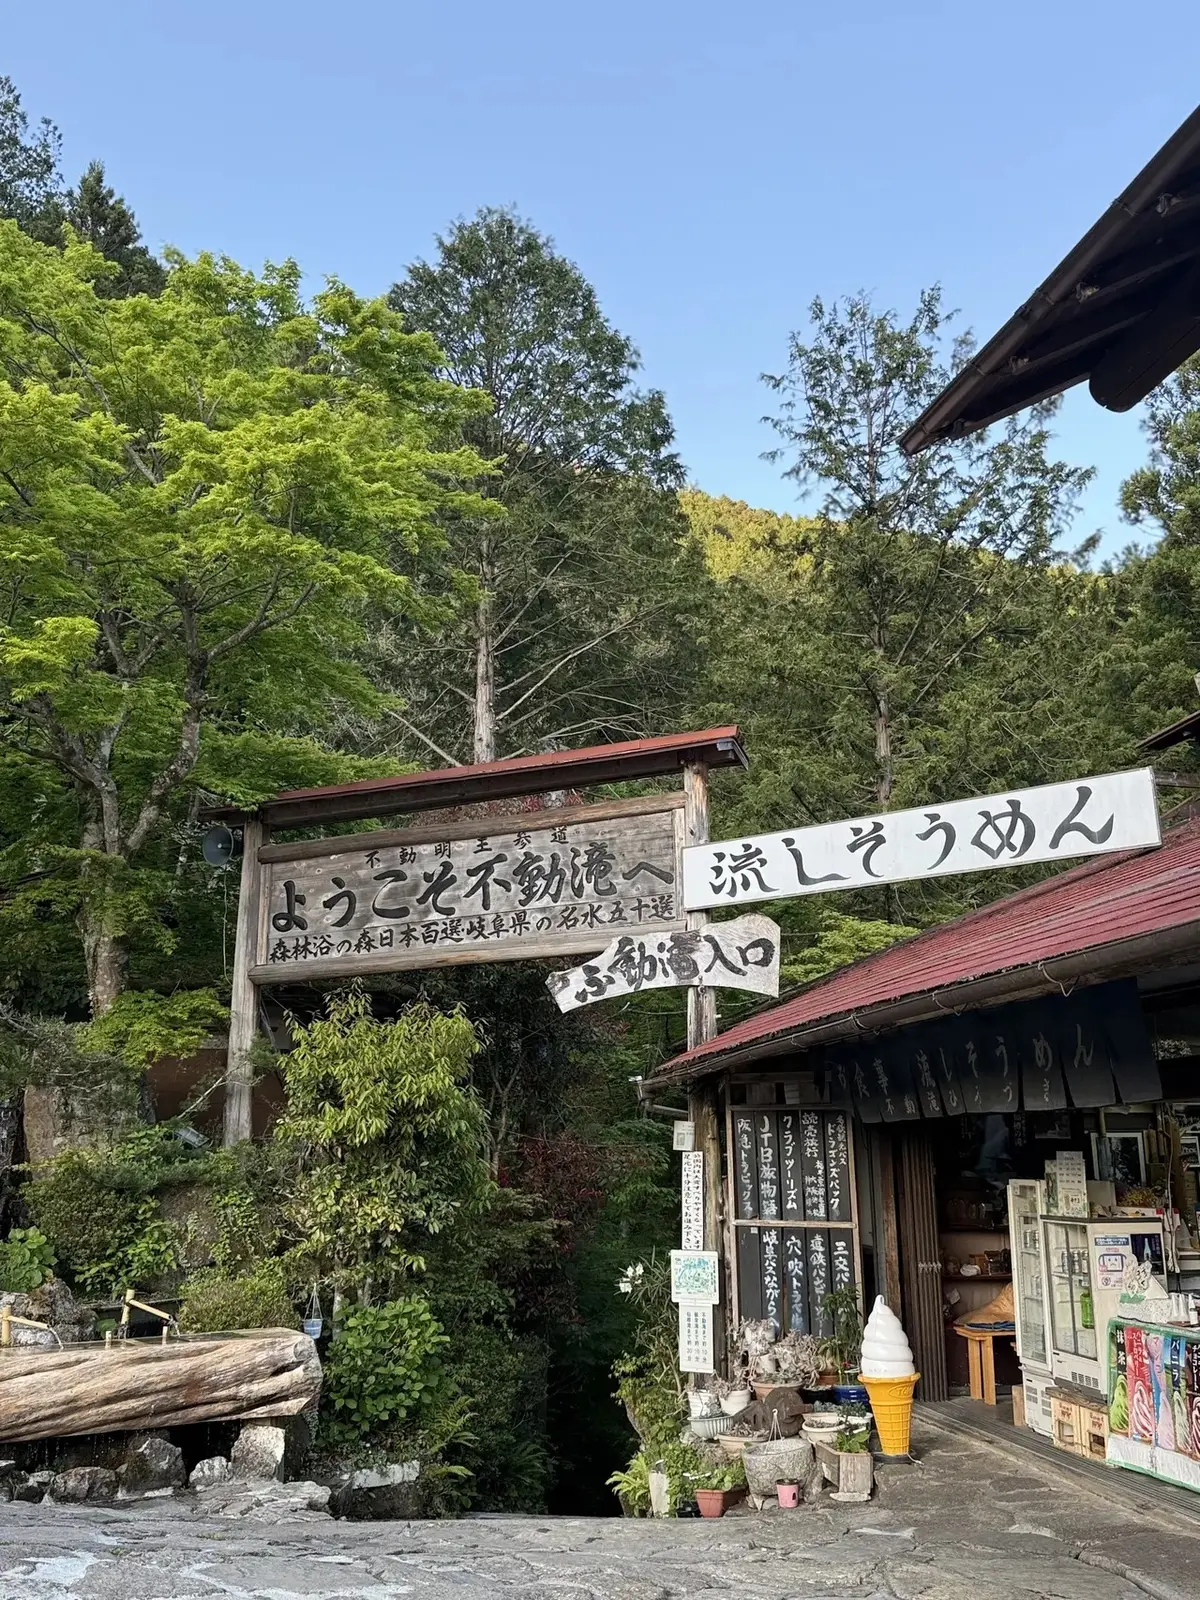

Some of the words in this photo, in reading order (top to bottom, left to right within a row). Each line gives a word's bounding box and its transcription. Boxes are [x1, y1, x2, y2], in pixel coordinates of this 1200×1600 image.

[364, 826, 570, 869] 不動明王参道
[708, 785, 1115, 898] 流しそうめん
[271, 842, 675, 933] ようこそ不動滝へ
[737, 1118, 753, 1211] 阪急トラピックス
[783, 1115, 798, 1210] クラブツーリズム
[801, 1112, 819, 1158] 読売旅行
[827, 1122, 841, 1210] ドラゴンズパック
[1116, 1329, 1126, 1365] 抹茶
[1171, 1340, 1181, 1382] バニラ
[1191, 1345, 1200, 1391] チョコレート
